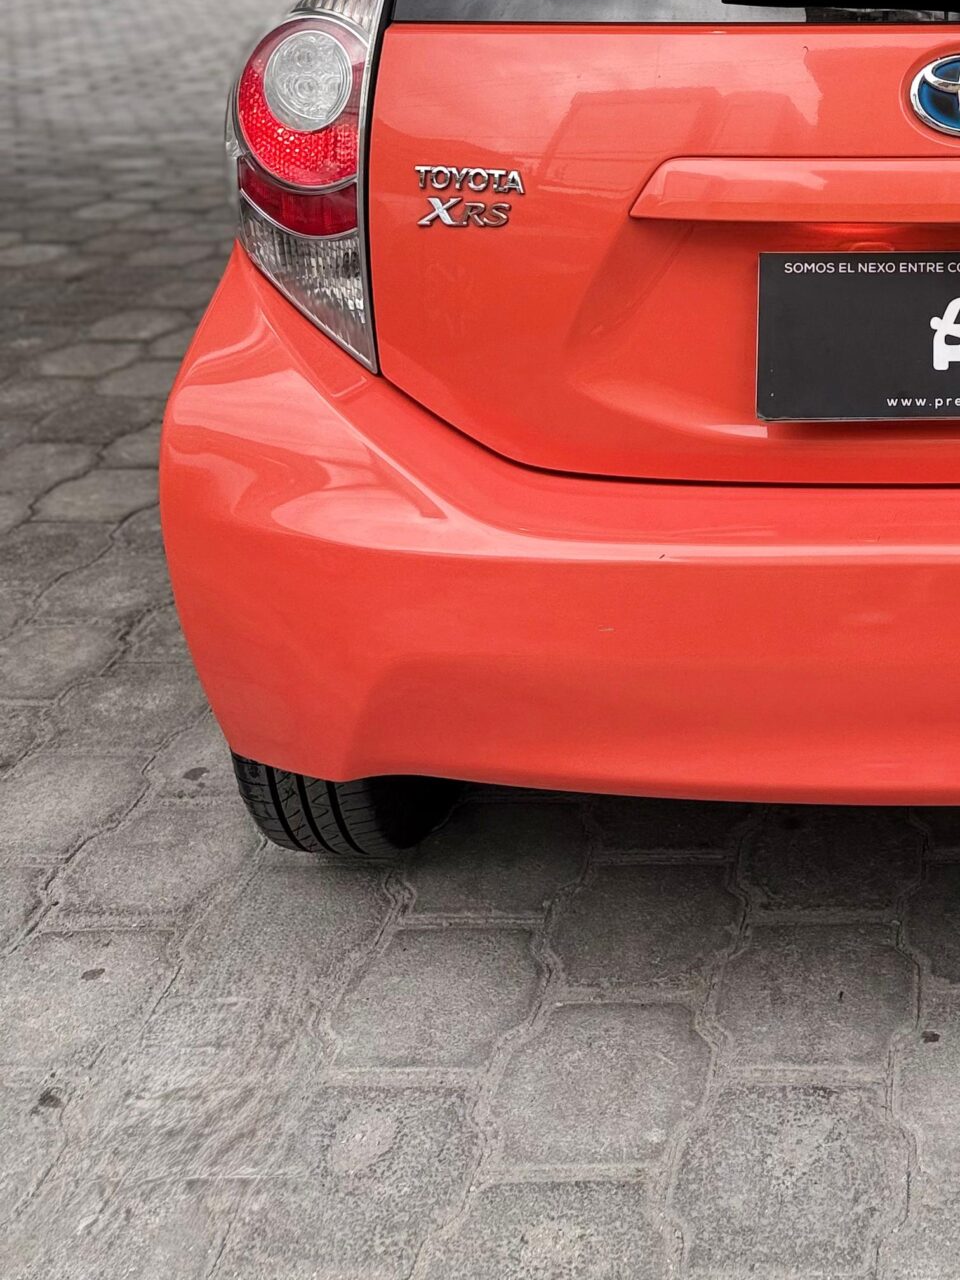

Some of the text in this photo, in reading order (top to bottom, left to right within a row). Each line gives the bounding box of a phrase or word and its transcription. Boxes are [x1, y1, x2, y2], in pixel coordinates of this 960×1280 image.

[415, 165, 525, 195] TOYOTA
[416, 197, 512, 227] XRS
[784, 262, 835, 273] SOMOS
[838, 262, 855, 273] EL
[858, 262, 896, 273] NEXO
[899, 262, 944, 273] ENTRE
